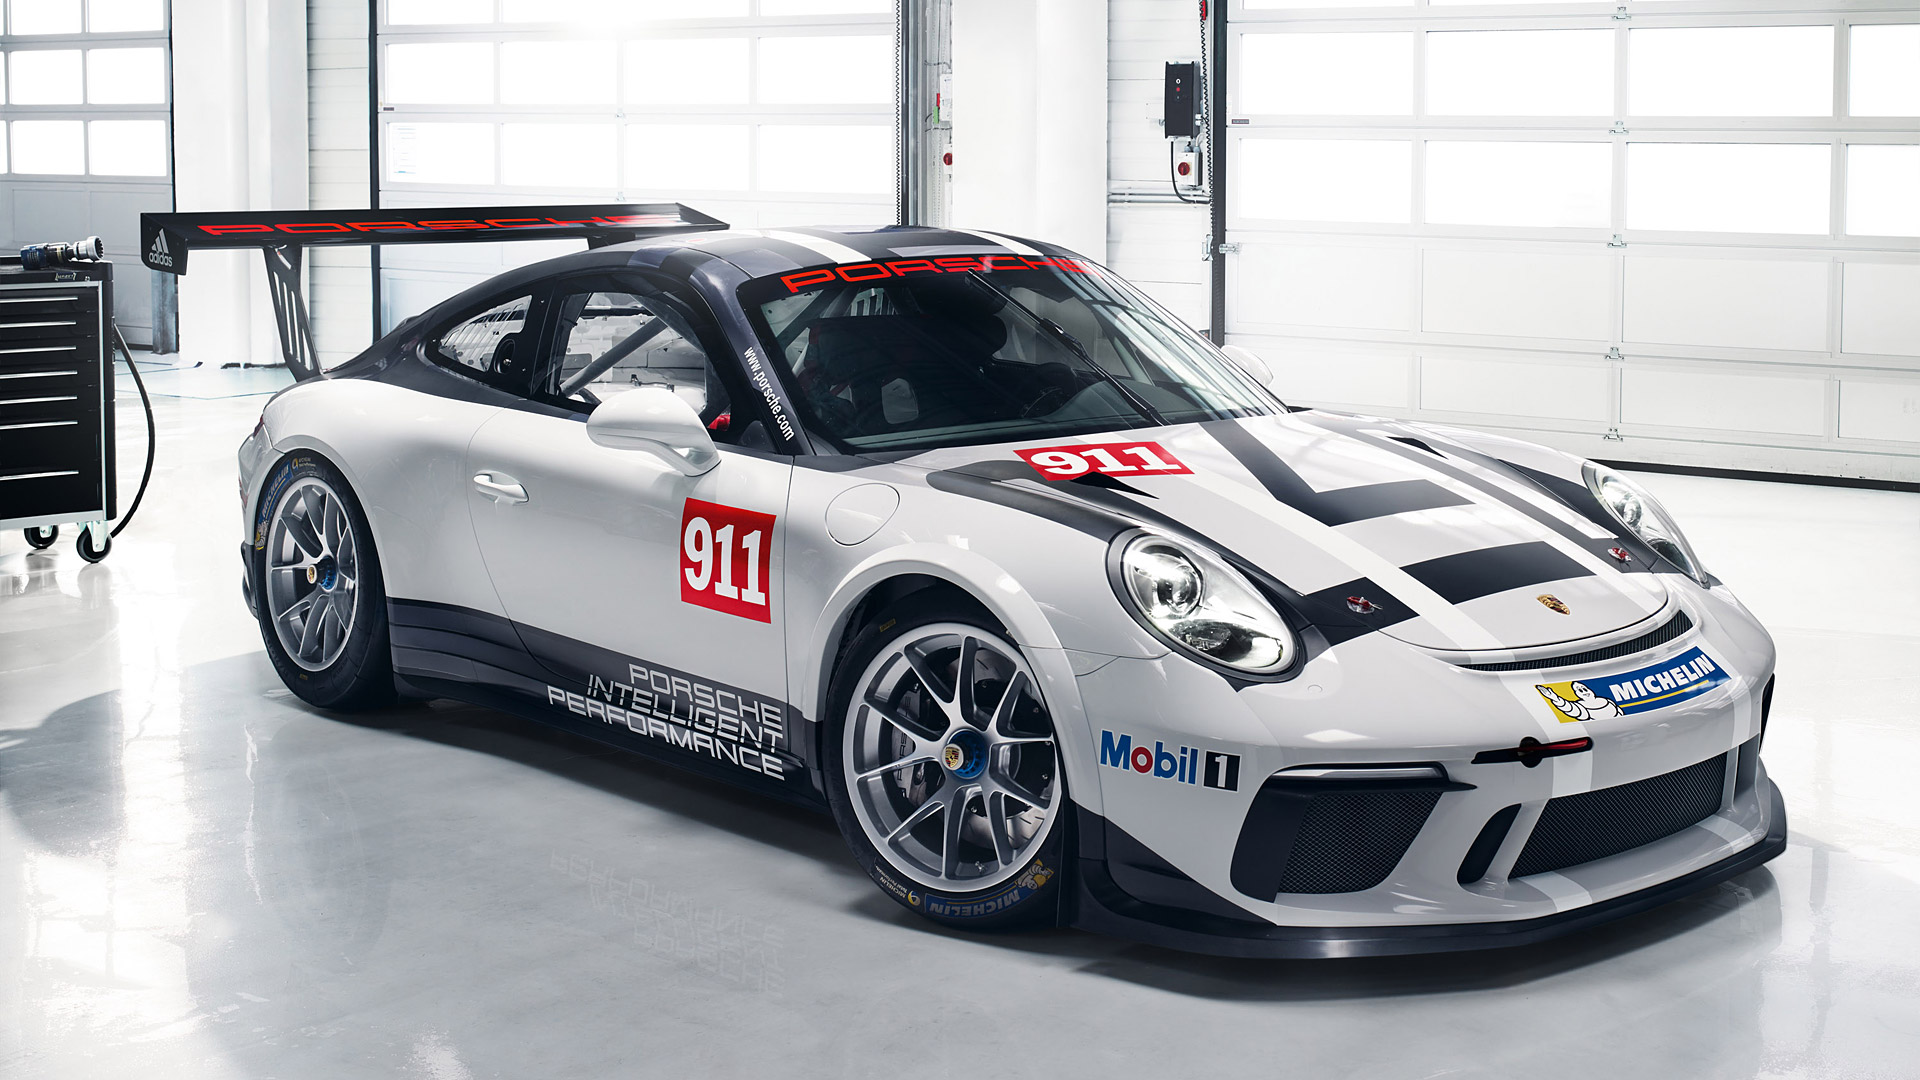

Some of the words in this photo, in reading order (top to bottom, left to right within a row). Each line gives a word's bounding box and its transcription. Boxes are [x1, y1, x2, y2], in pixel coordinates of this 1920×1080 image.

[197, 214, 676, 236] PORSCHE
[148, 250, 173, 267] adidas
[779, 255, 1102, 293] PORSCHE
[743, 346, 795, 441] www.porsche.com
[1030, 446, 1182, 475] 911
[684, 516, 766, 606] 911
[629, 663, 783, 731] PORSCHE
[1608, 653, 1716, 702] MICHELIN
[547, 685, 785, 781] PERFORMANCE
[587, 674, 783, 753] INTELLIGENT
[1099, 729, 1198, 785] Mobil
[879, 876, 906, 898] MICHELIN
[929, 889, 1020, 916] MICHELIN
